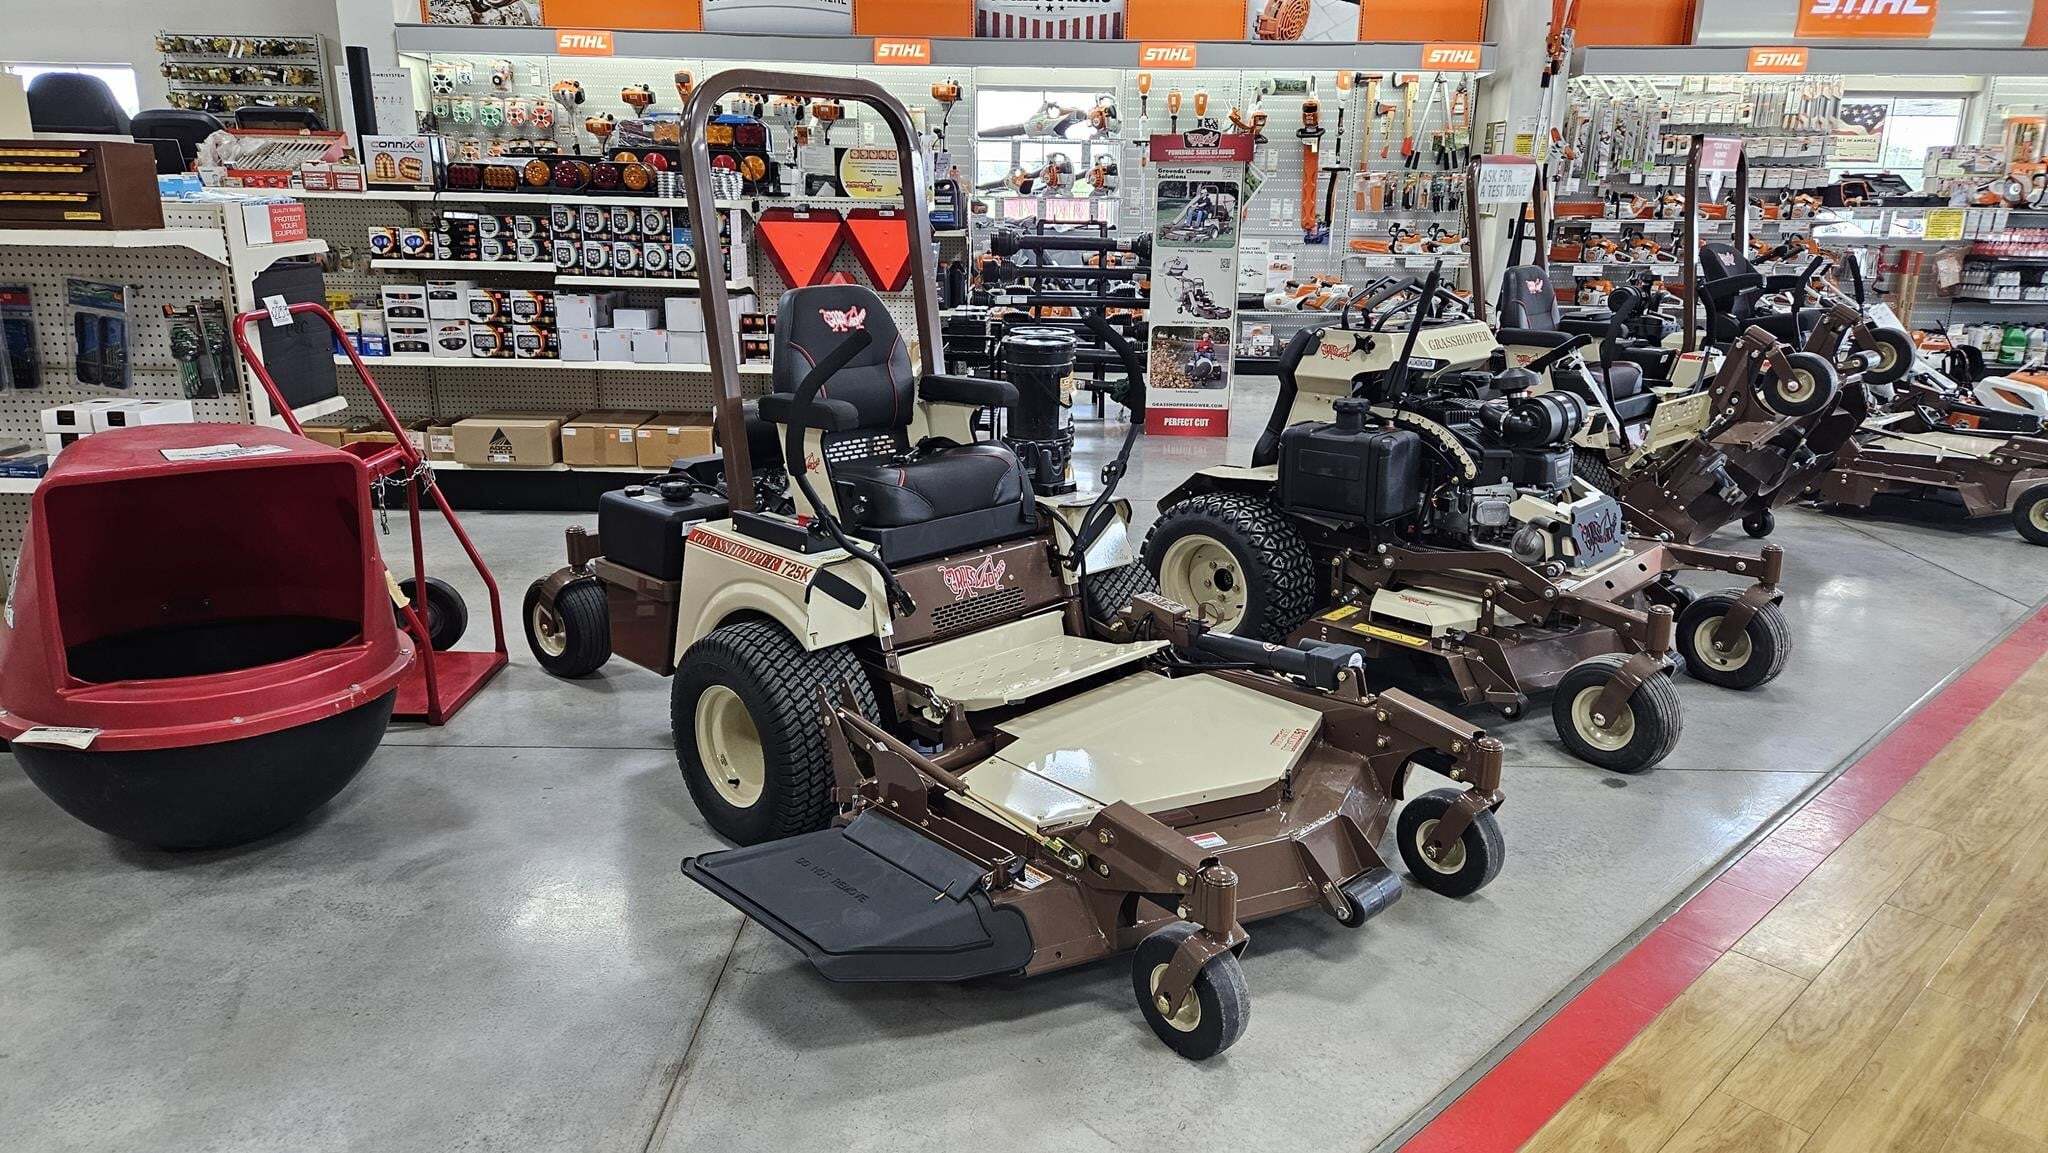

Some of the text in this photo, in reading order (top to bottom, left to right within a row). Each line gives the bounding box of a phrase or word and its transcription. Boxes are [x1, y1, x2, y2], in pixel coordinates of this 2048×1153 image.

[559, 34, 607, 49] STIHL
[877, 43, 925, 58] STIHL
[1144, 47, 1191, 61] STIHL
[1428, 49, 1476, 63] STIHL
[1754, 53, 1803, 66] STIHL
[1482, 169, 1513, 183] ASK FOR
[1479, 184, 1528, 198] A TEST DRIVE
[273, 215, 301, 223] PROTECT
[280, 222, 298, 230] YOUR
[275, 228, 305, 237] EQUIPMENT
[1428, 331, 1491, 351] GRASSHOPPER
[1163, 417, 1210, 427] PERFECT CUT
[692, 531, 813, 583] GRASSHOPPER 725K
[810, 866, 833, 879] NOT
[831, 878, 870, 903] REMOVE
